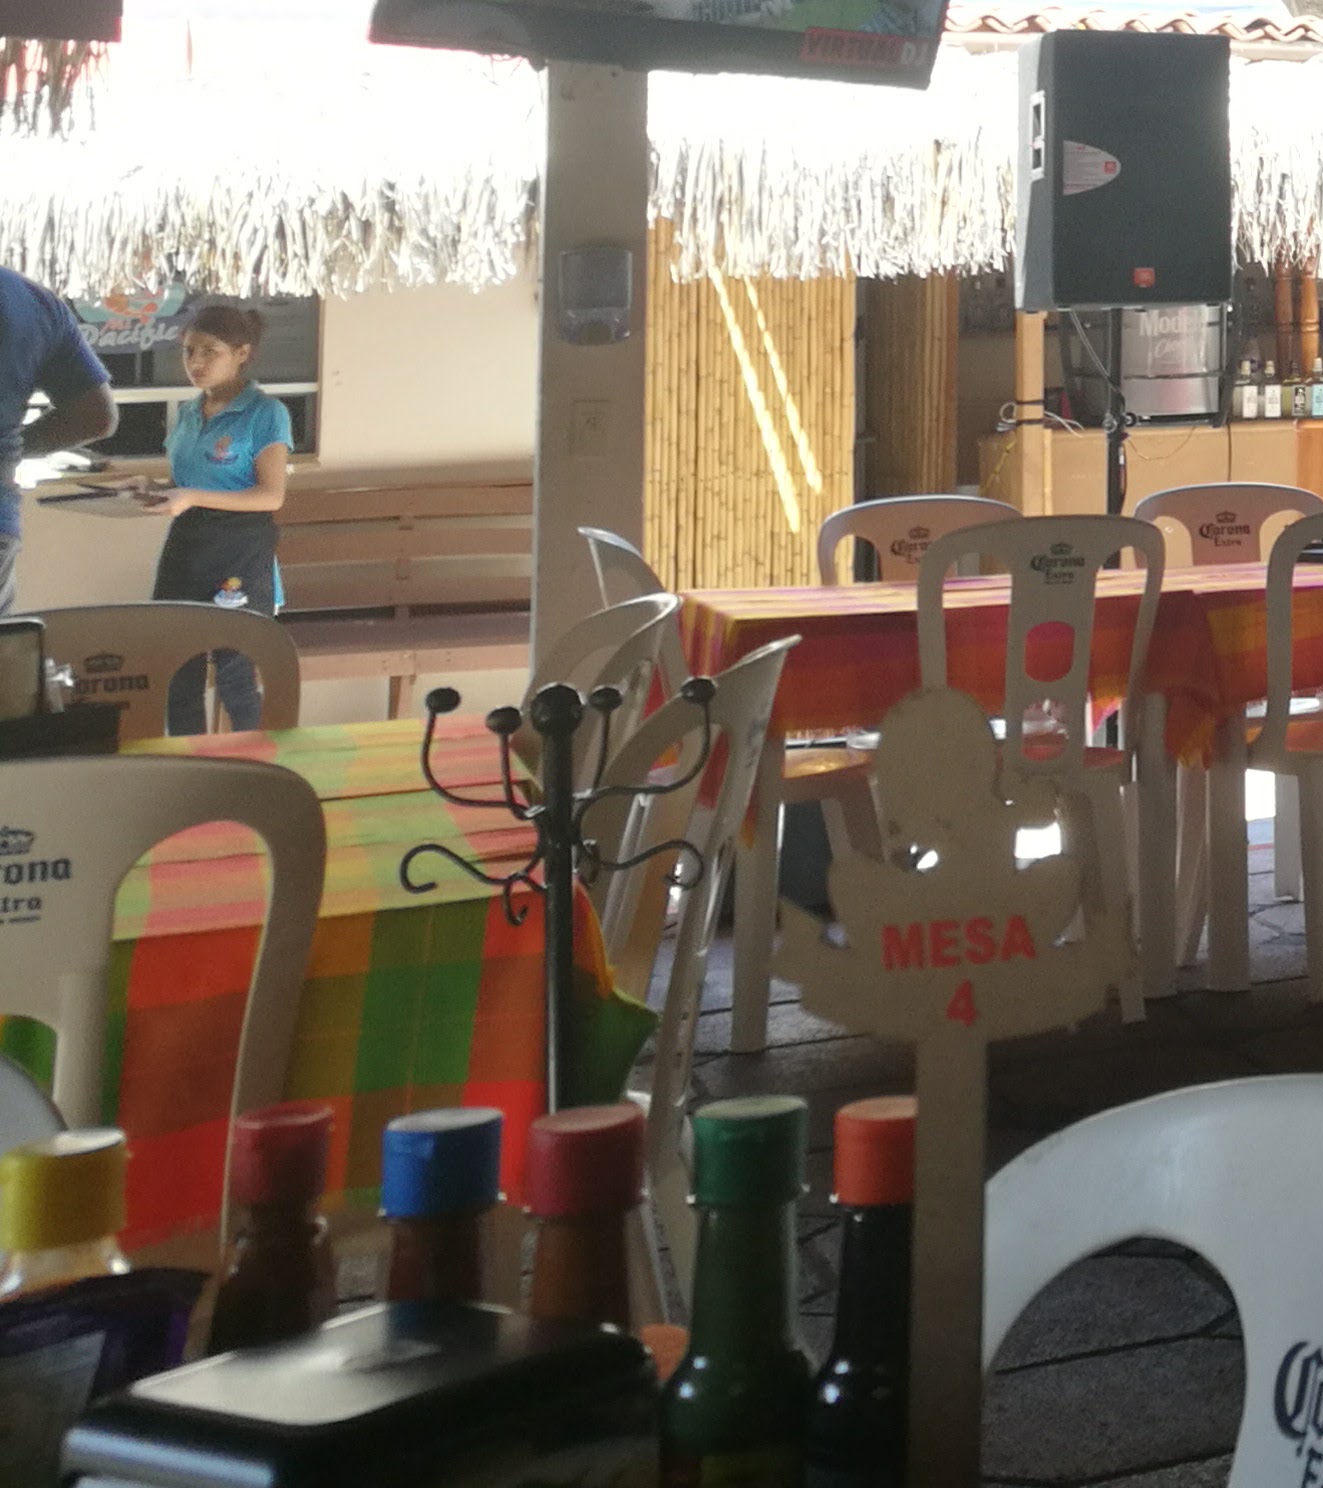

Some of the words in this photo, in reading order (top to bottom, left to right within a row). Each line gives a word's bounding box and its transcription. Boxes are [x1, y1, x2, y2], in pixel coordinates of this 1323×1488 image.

[79, 316, 180, 352] Pacific
[1199, 522, 1251, 540] Corona
[1214, 536, 1242, 547] Extra
[1030, 554, 1086, 573] Corona
[73, 674, 149, 696] orona
[0, 858, 71, 885] ona
[881, 914, 1036, 970] MESA
[945, 978, 979, 1027] 4
